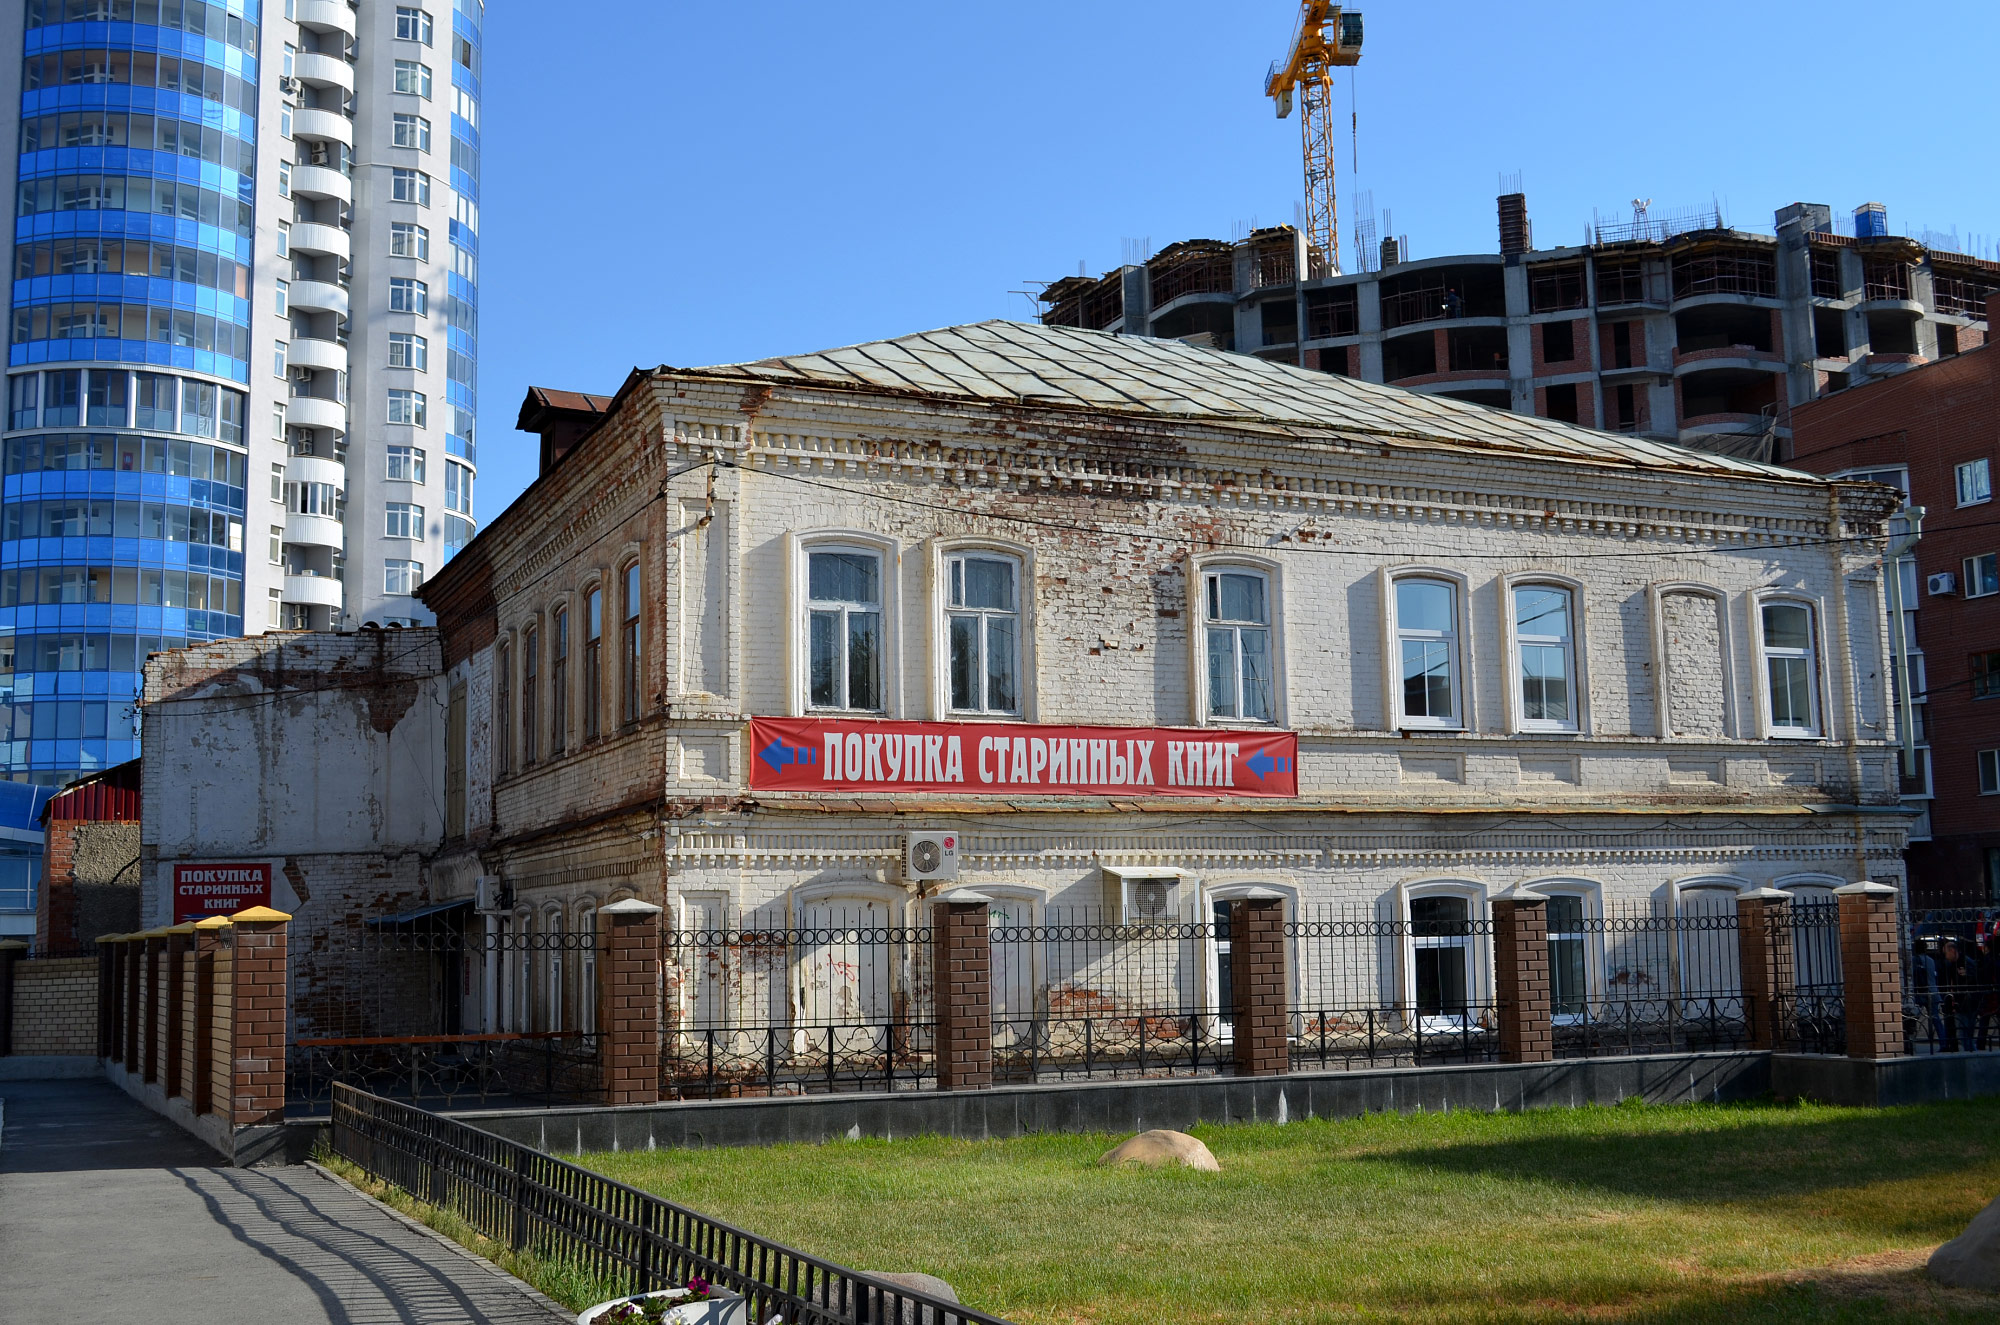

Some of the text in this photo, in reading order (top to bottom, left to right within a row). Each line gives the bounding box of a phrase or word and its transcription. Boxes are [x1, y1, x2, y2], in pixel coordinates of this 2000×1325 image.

[823, 732, 1239, 787] ПОКУПКА СТАРИННЫХ КНИГ
[181, 870, 263, 882] ПОКУПКА
[180, 884, 263, 895] СТАРИННЫХ
[204, 898, 240, 909] КНИГ
